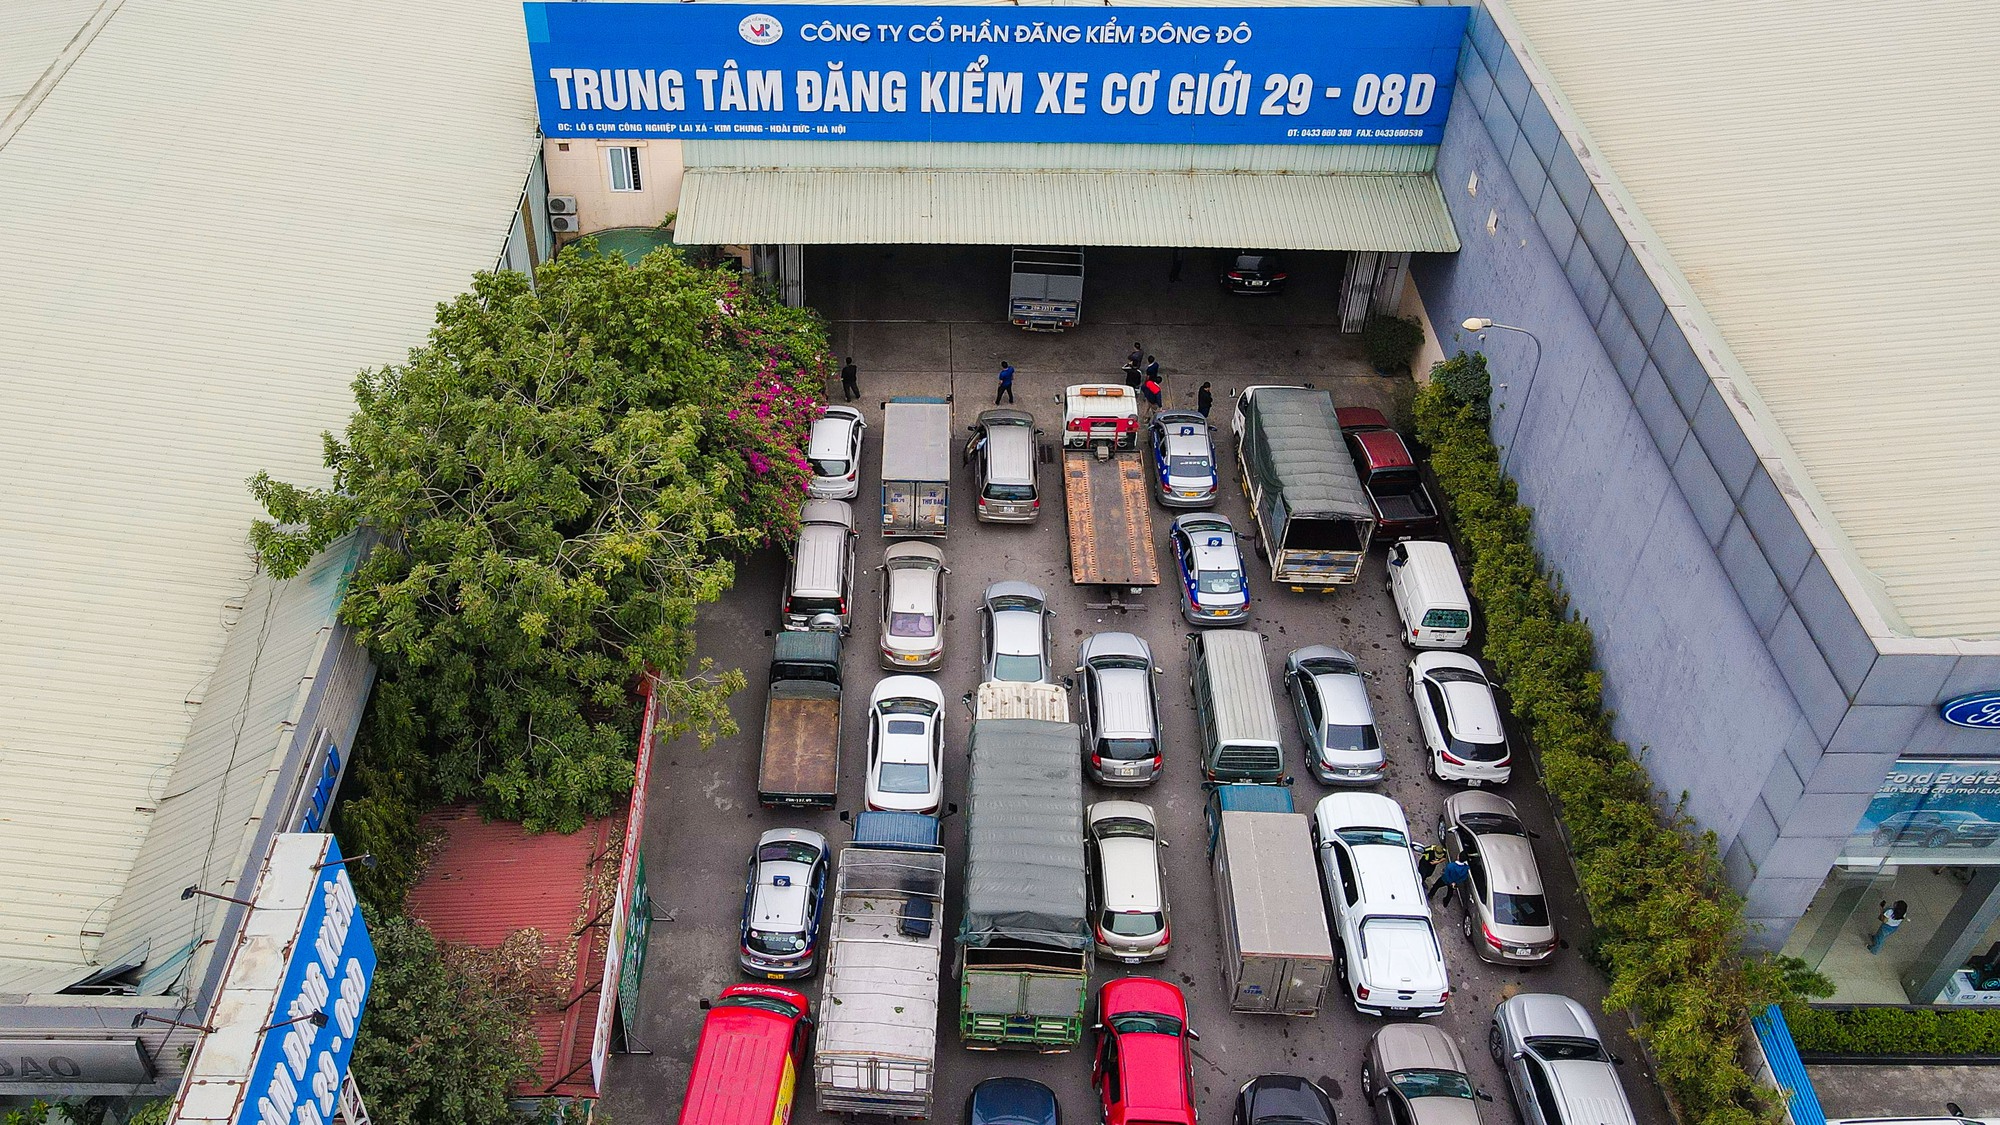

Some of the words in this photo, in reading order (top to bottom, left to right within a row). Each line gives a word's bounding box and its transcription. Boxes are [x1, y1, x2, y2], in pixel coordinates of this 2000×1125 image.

[800, 20, 871, 42] CÔNG
[878, 25, 904, 42] TY
[909, 16, 945, 42] CỔ
[951, 18, 1009, 43] PHẦN
[1014, 22, 1082, 43] ĐĂNG
[1086, 16, 1135, 44] KIỂM
[1140, 22, 1211, 44] ĐÔNG
[1216, 22, 1252, 44] ĐÔ
[550, 69, 685, 111] TRUNG
[695, 60, 784, 112] TÂM
[796, 61, 907, 113] ĐĂNG
[920, 54, 1024, 114] KIỂM
[1035, 73, 1088, 114] XE
[1101, 70, 1161, 115] CƠ
[1168, 60, 1252, 116] GIỚI
[1260, 74, 1314, 116] 29
[1325, 88, 1341, 98] -
[1352, 74, 1436, 116] 08D
[576, 122, 587, 132] LÔ
[588, 123, 595, 132] 6
[596, 123, 616, 133] CỤM
[619, 122, 643, 132] CÔNG
[645, 122, 677, 133] NGHIỆP
[679, 124, 693, 132] LAI
[714, 124, 731, 132] KIM
[769, 123, 791, 133] HOÀI
[792, 124, 810, 133] ĐỨC
[816, 124, 829, 133] HÀ
[831, 124, 846, 135] NỘI
[1301, 129, 1320, 137] 0433
[1356, 129, 1374, 137] FAX:
[1885, 771, 1935, 784] Ford
[314, 868, 357, 979] KIỂM
[312, 1050, 339, 1118] 29
[334, 957, 366, 1040] 08D
